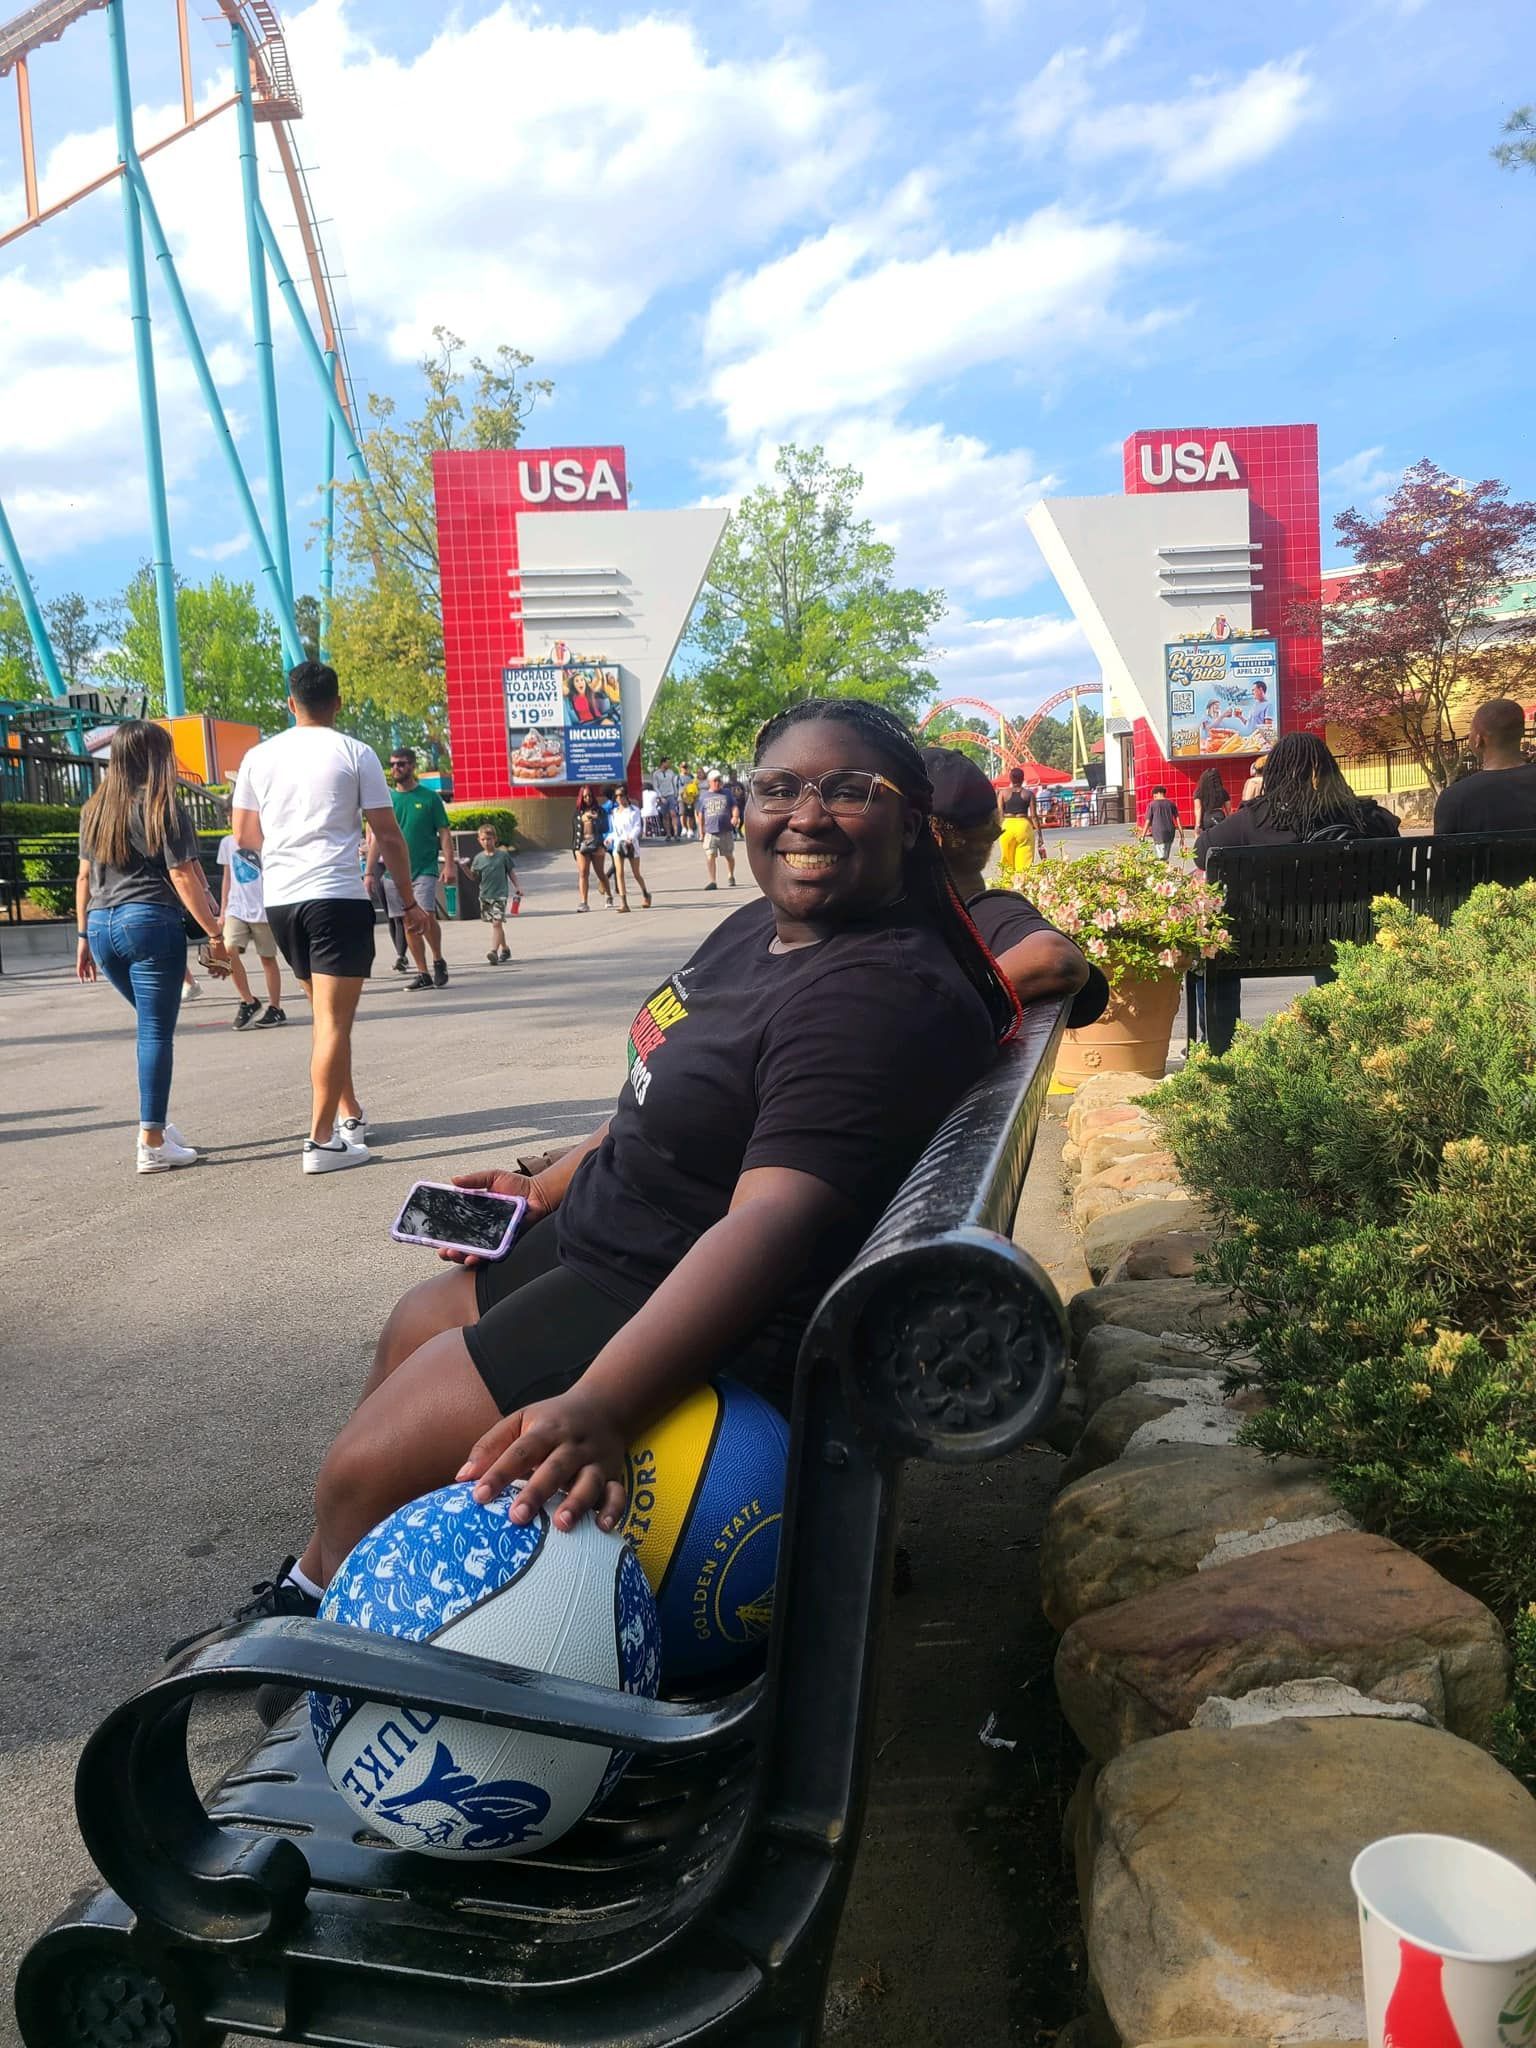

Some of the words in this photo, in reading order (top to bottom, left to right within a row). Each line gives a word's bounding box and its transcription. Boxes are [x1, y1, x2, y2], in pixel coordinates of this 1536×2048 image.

[1141, 441, 1240, 485] USA
[518, 459, 622, 503] USA
[1169, 651, 1226, 669] Brews
[507, 670, 555, 681] UPGRADE
[1191, 667, 1226, 681] Bites
[505, 682, 521, 691] TO
[524, 681, 530, 691] A
[532, 681, 557, 691] PASS
[507, 692, 558, 702] TODAY!
[569, 728, 620, 740] INCLUDES:
[646, 985, 688, 1031] BLACK
[692, 1559, 718, 1640] GOLDEN
[714, 1499, 762, 1553] STATE
[342, 1705, 441, 1808] DUKE
